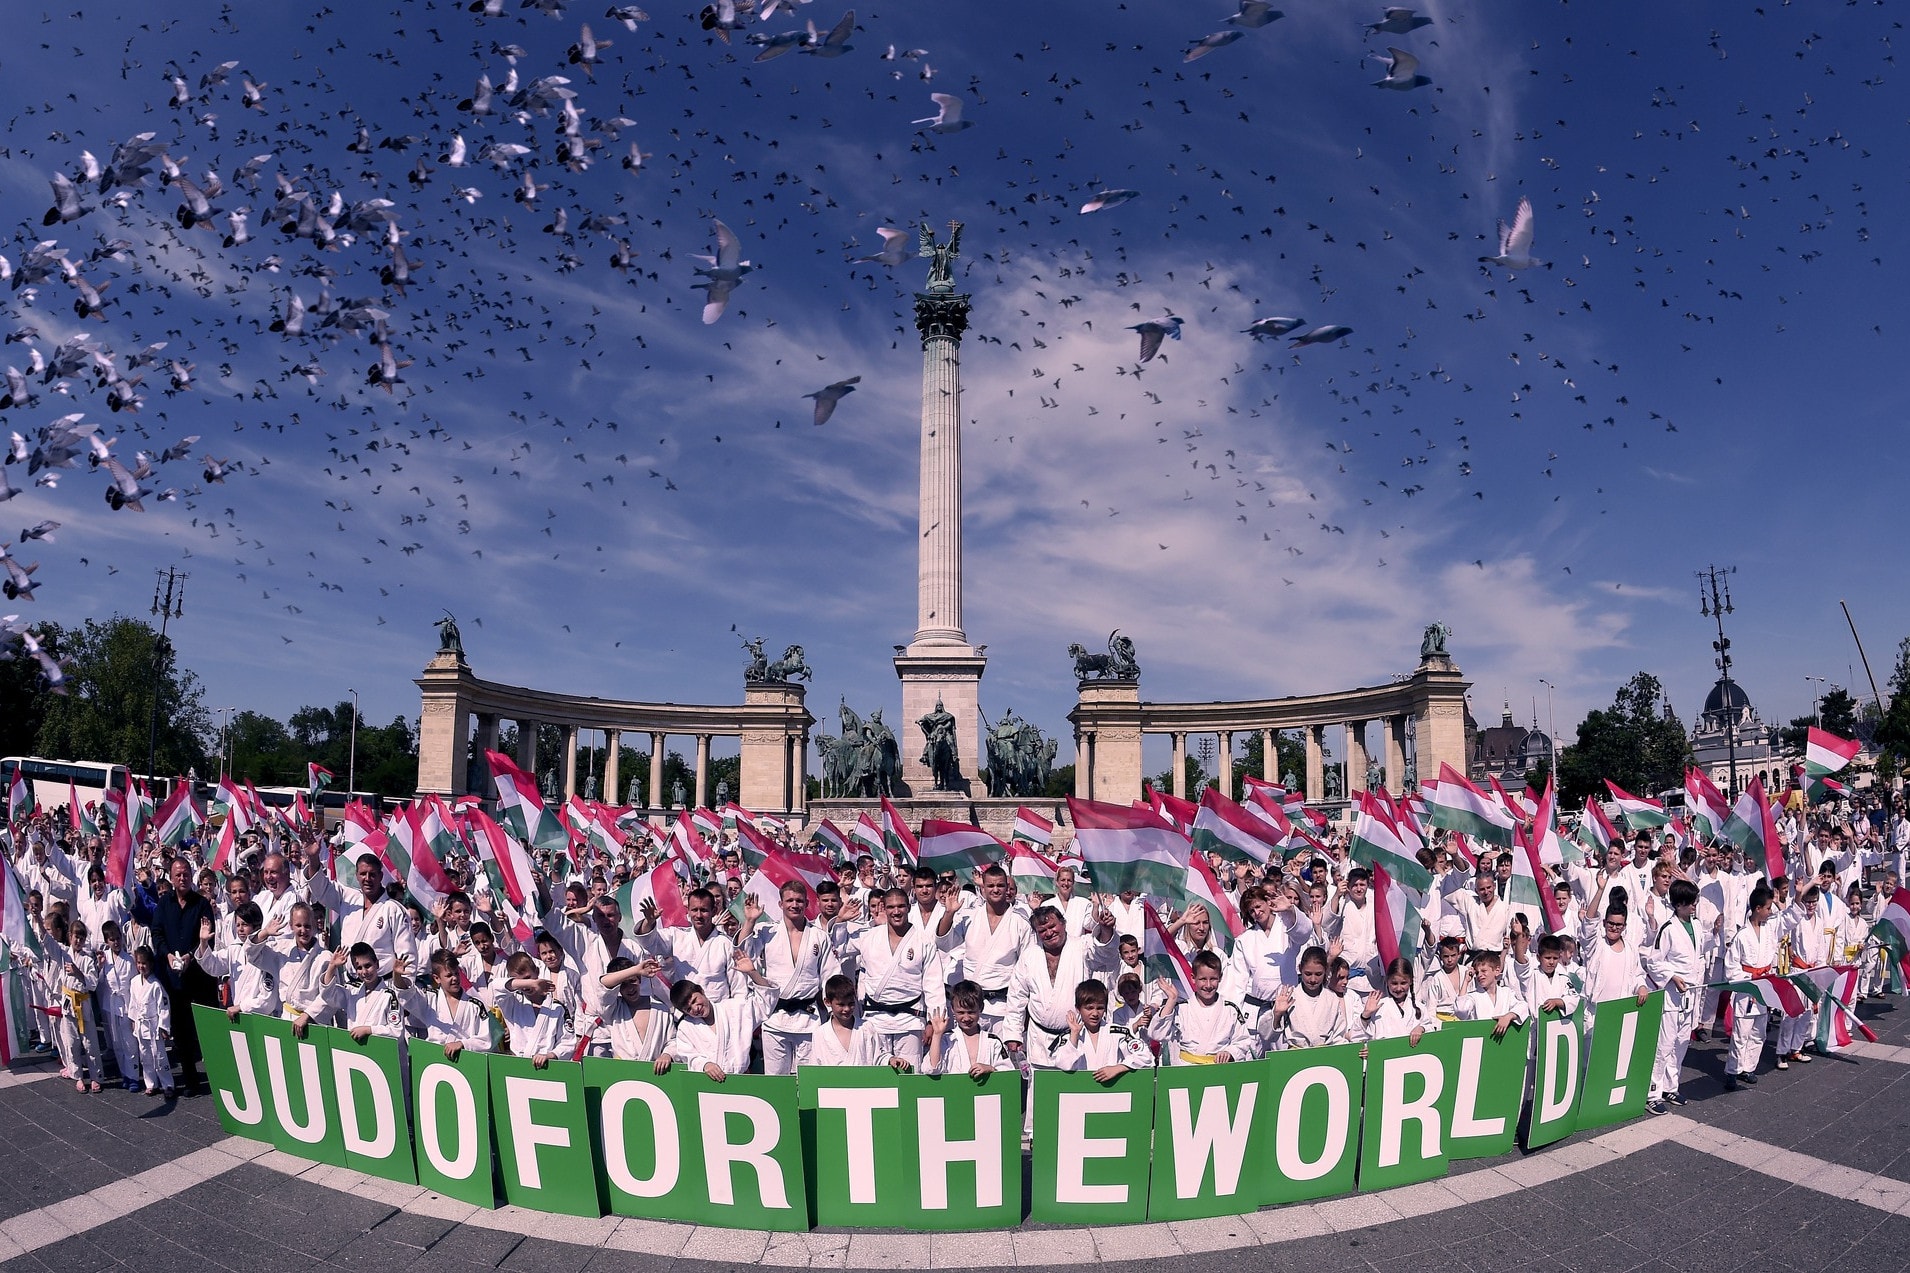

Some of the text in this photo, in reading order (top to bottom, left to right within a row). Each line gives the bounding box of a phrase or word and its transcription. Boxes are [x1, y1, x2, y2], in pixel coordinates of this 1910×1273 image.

[219, 1031, 479, 1180] JUDO
[505, 1077, 793, 1209] FOR
[817, 1083, 1133, 1210] THE
